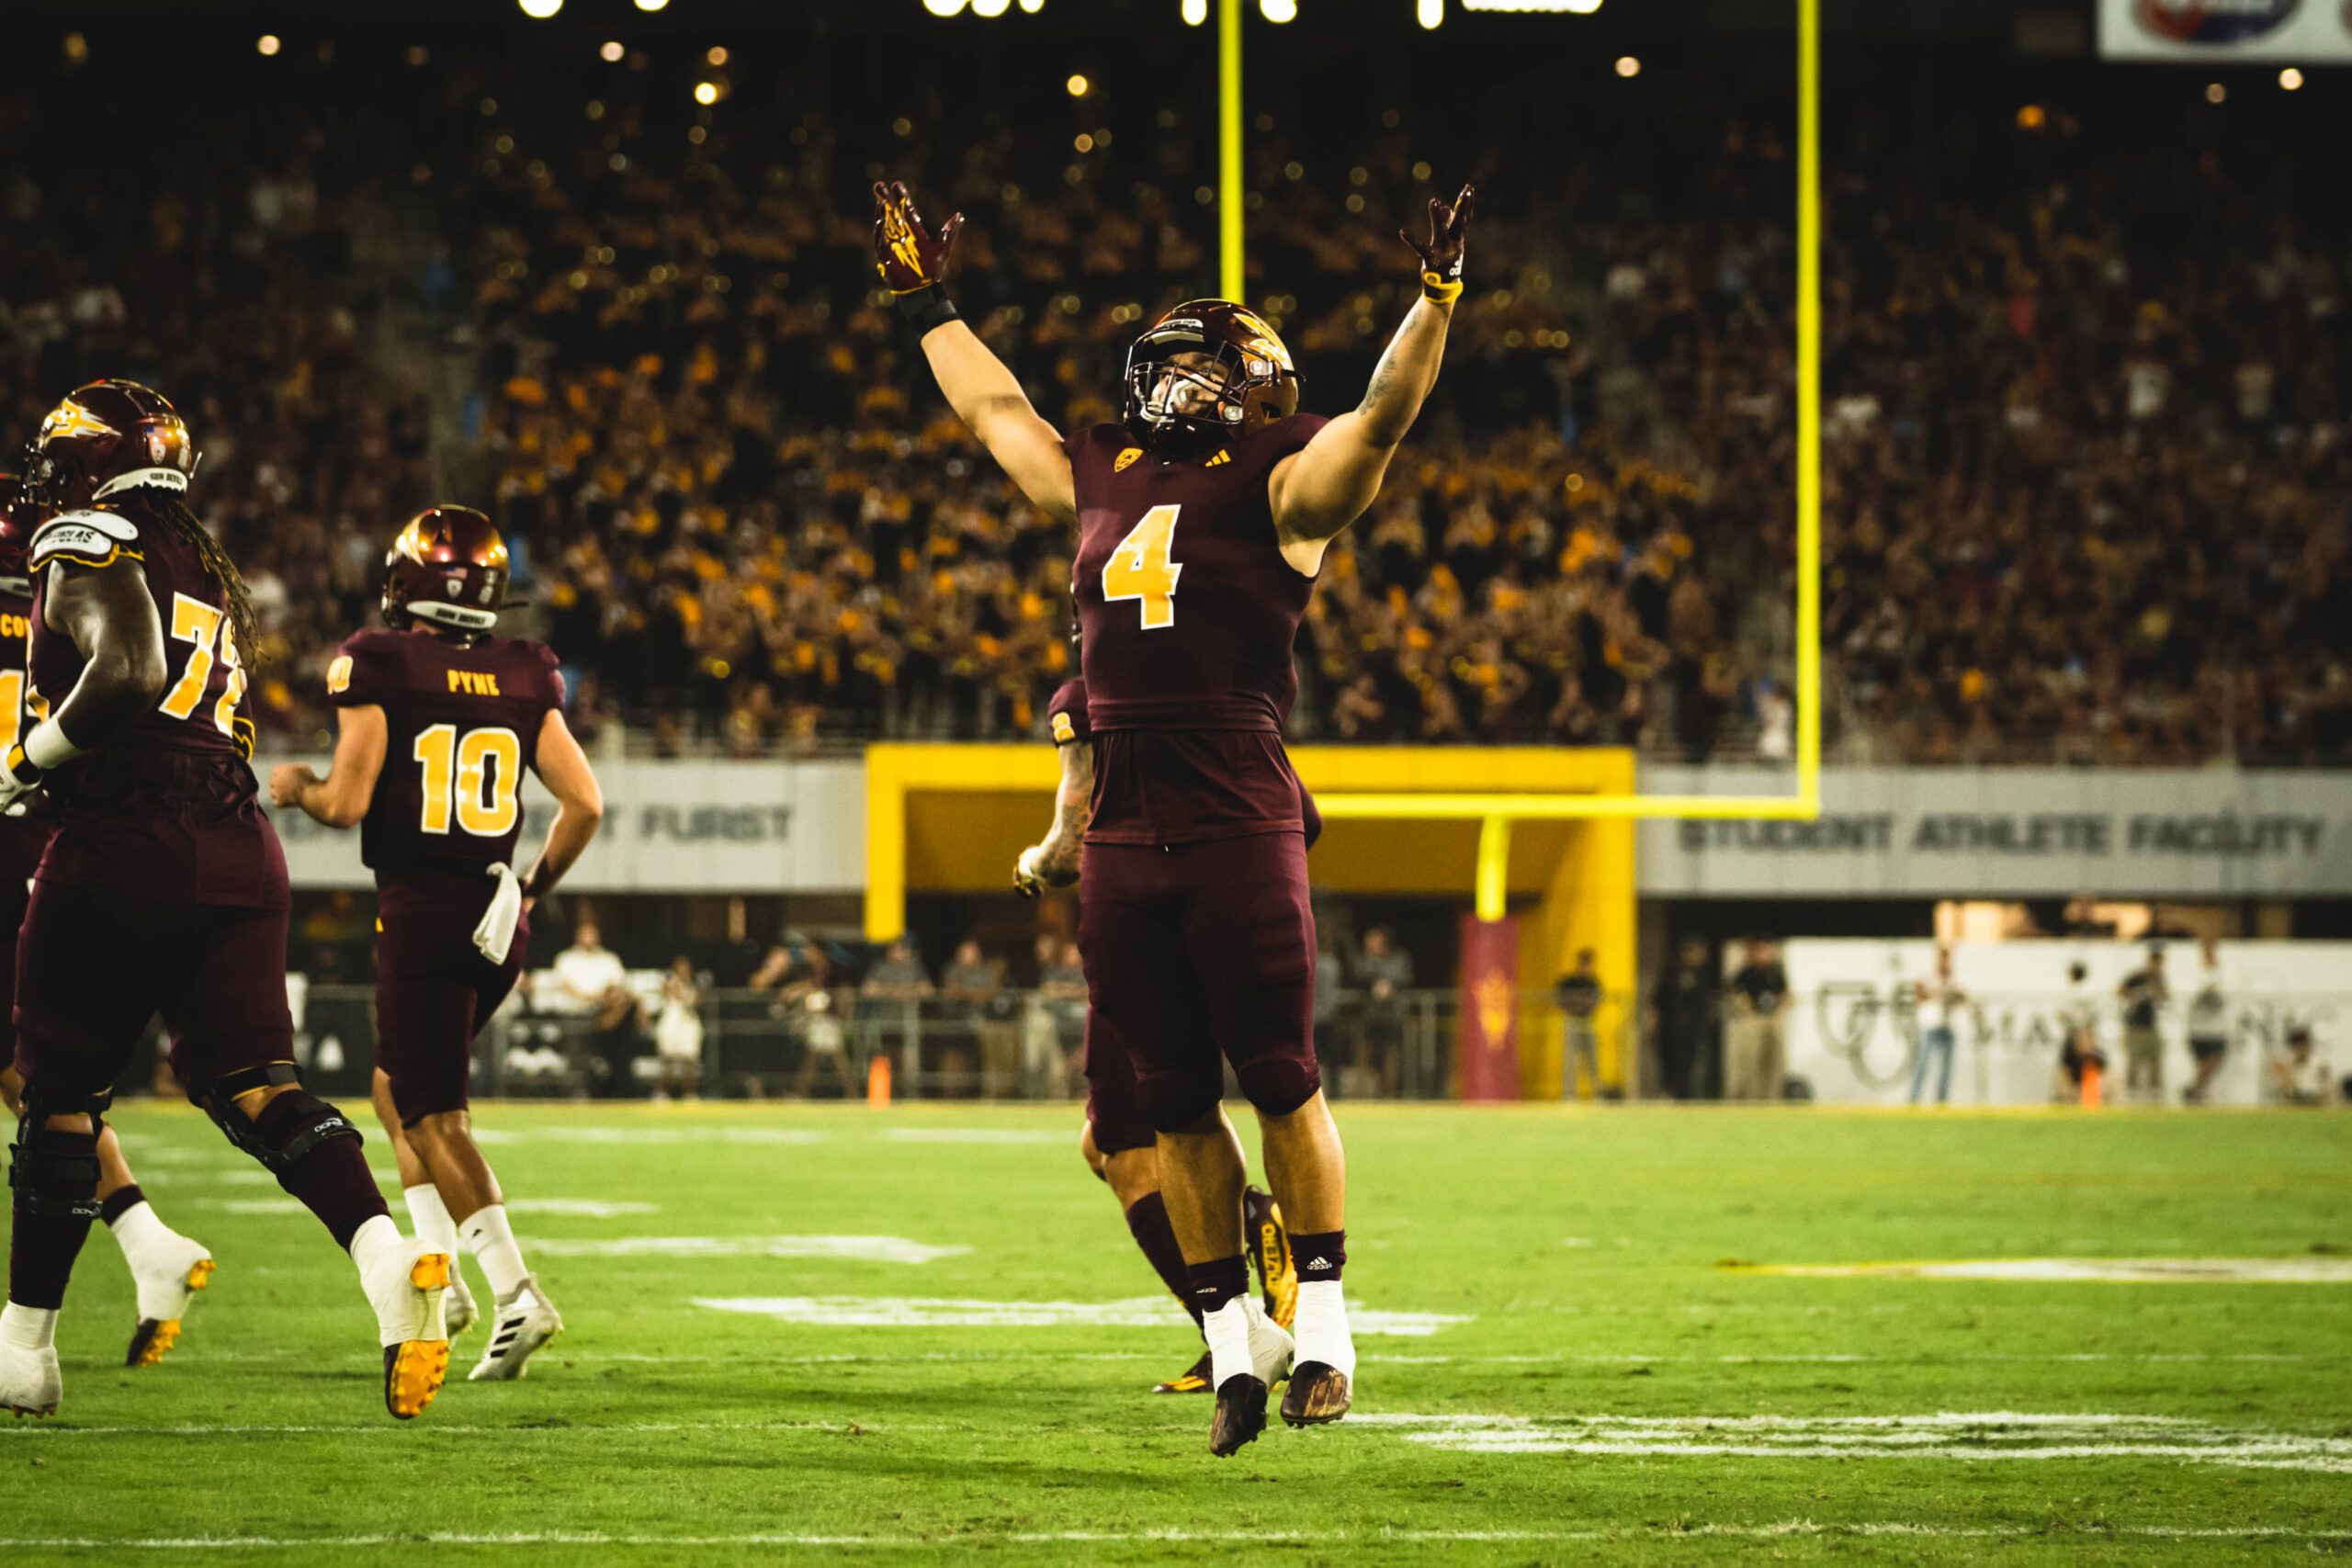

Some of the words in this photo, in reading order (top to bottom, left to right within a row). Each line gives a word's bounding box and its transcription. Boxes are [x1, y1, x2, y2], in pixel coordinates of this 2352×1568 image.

[1102, 504, 1183, 630] 4
[447, 669, 500, 696] PYNE
[413, 723, 521, 837] 10
[638, 803, 793, 845] FURST
[1678, 811, 1894, 854] STUDENT
[1909, 813, 2111, 856] ATHLETE
[2127, 813, 2324, 857] FACILITY
